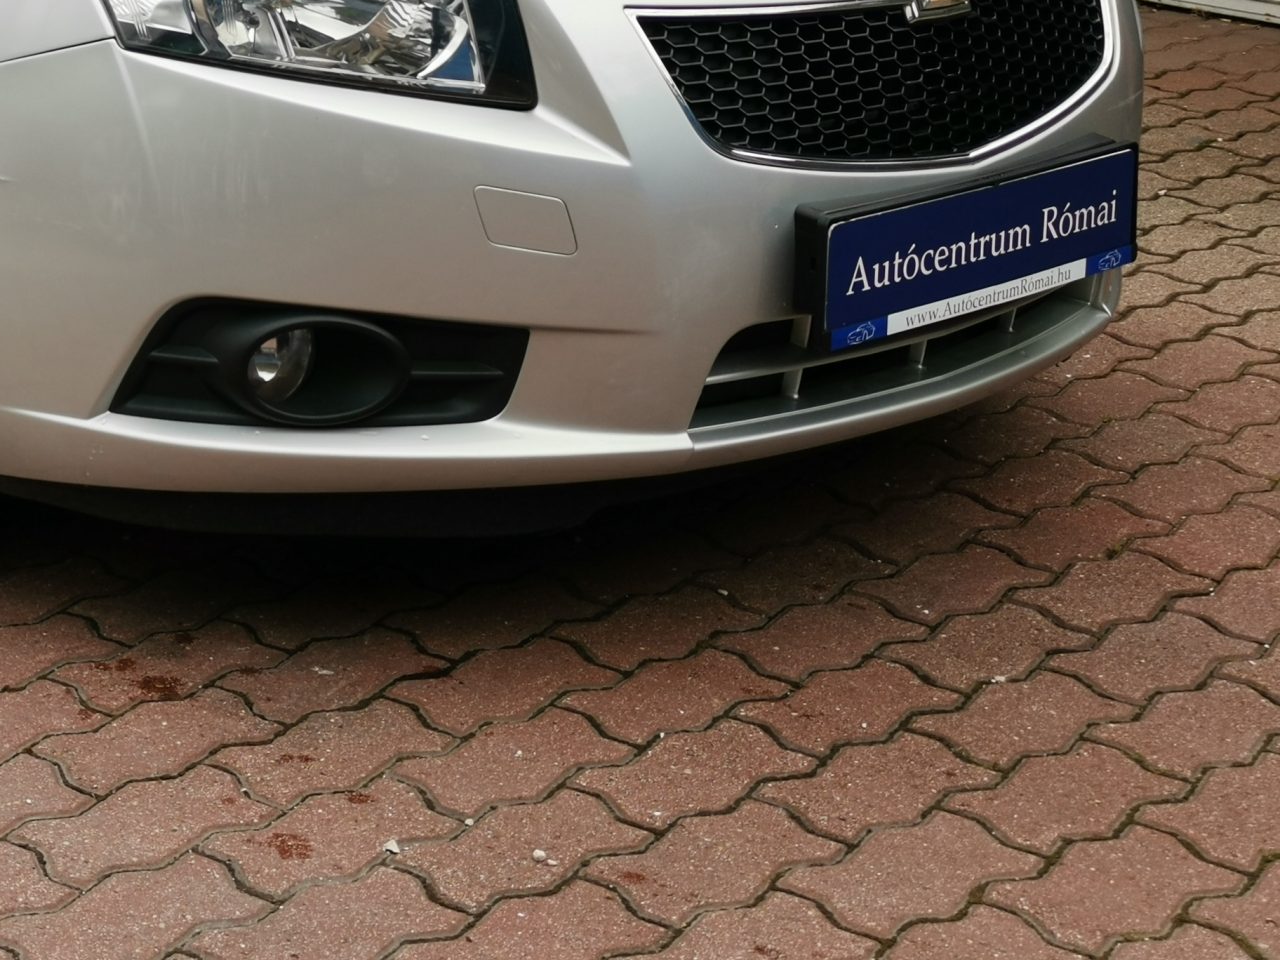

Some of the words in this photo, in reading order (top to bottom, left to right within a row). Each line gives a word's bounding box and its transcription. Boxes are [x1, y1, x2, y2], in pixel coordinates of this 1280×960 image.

[846, 224, 1032, 295] Autócentrum
[1040, 189, 1117, 243] Római
[905, 267, 1072, 328] www.AutócentrumRómai.hu
